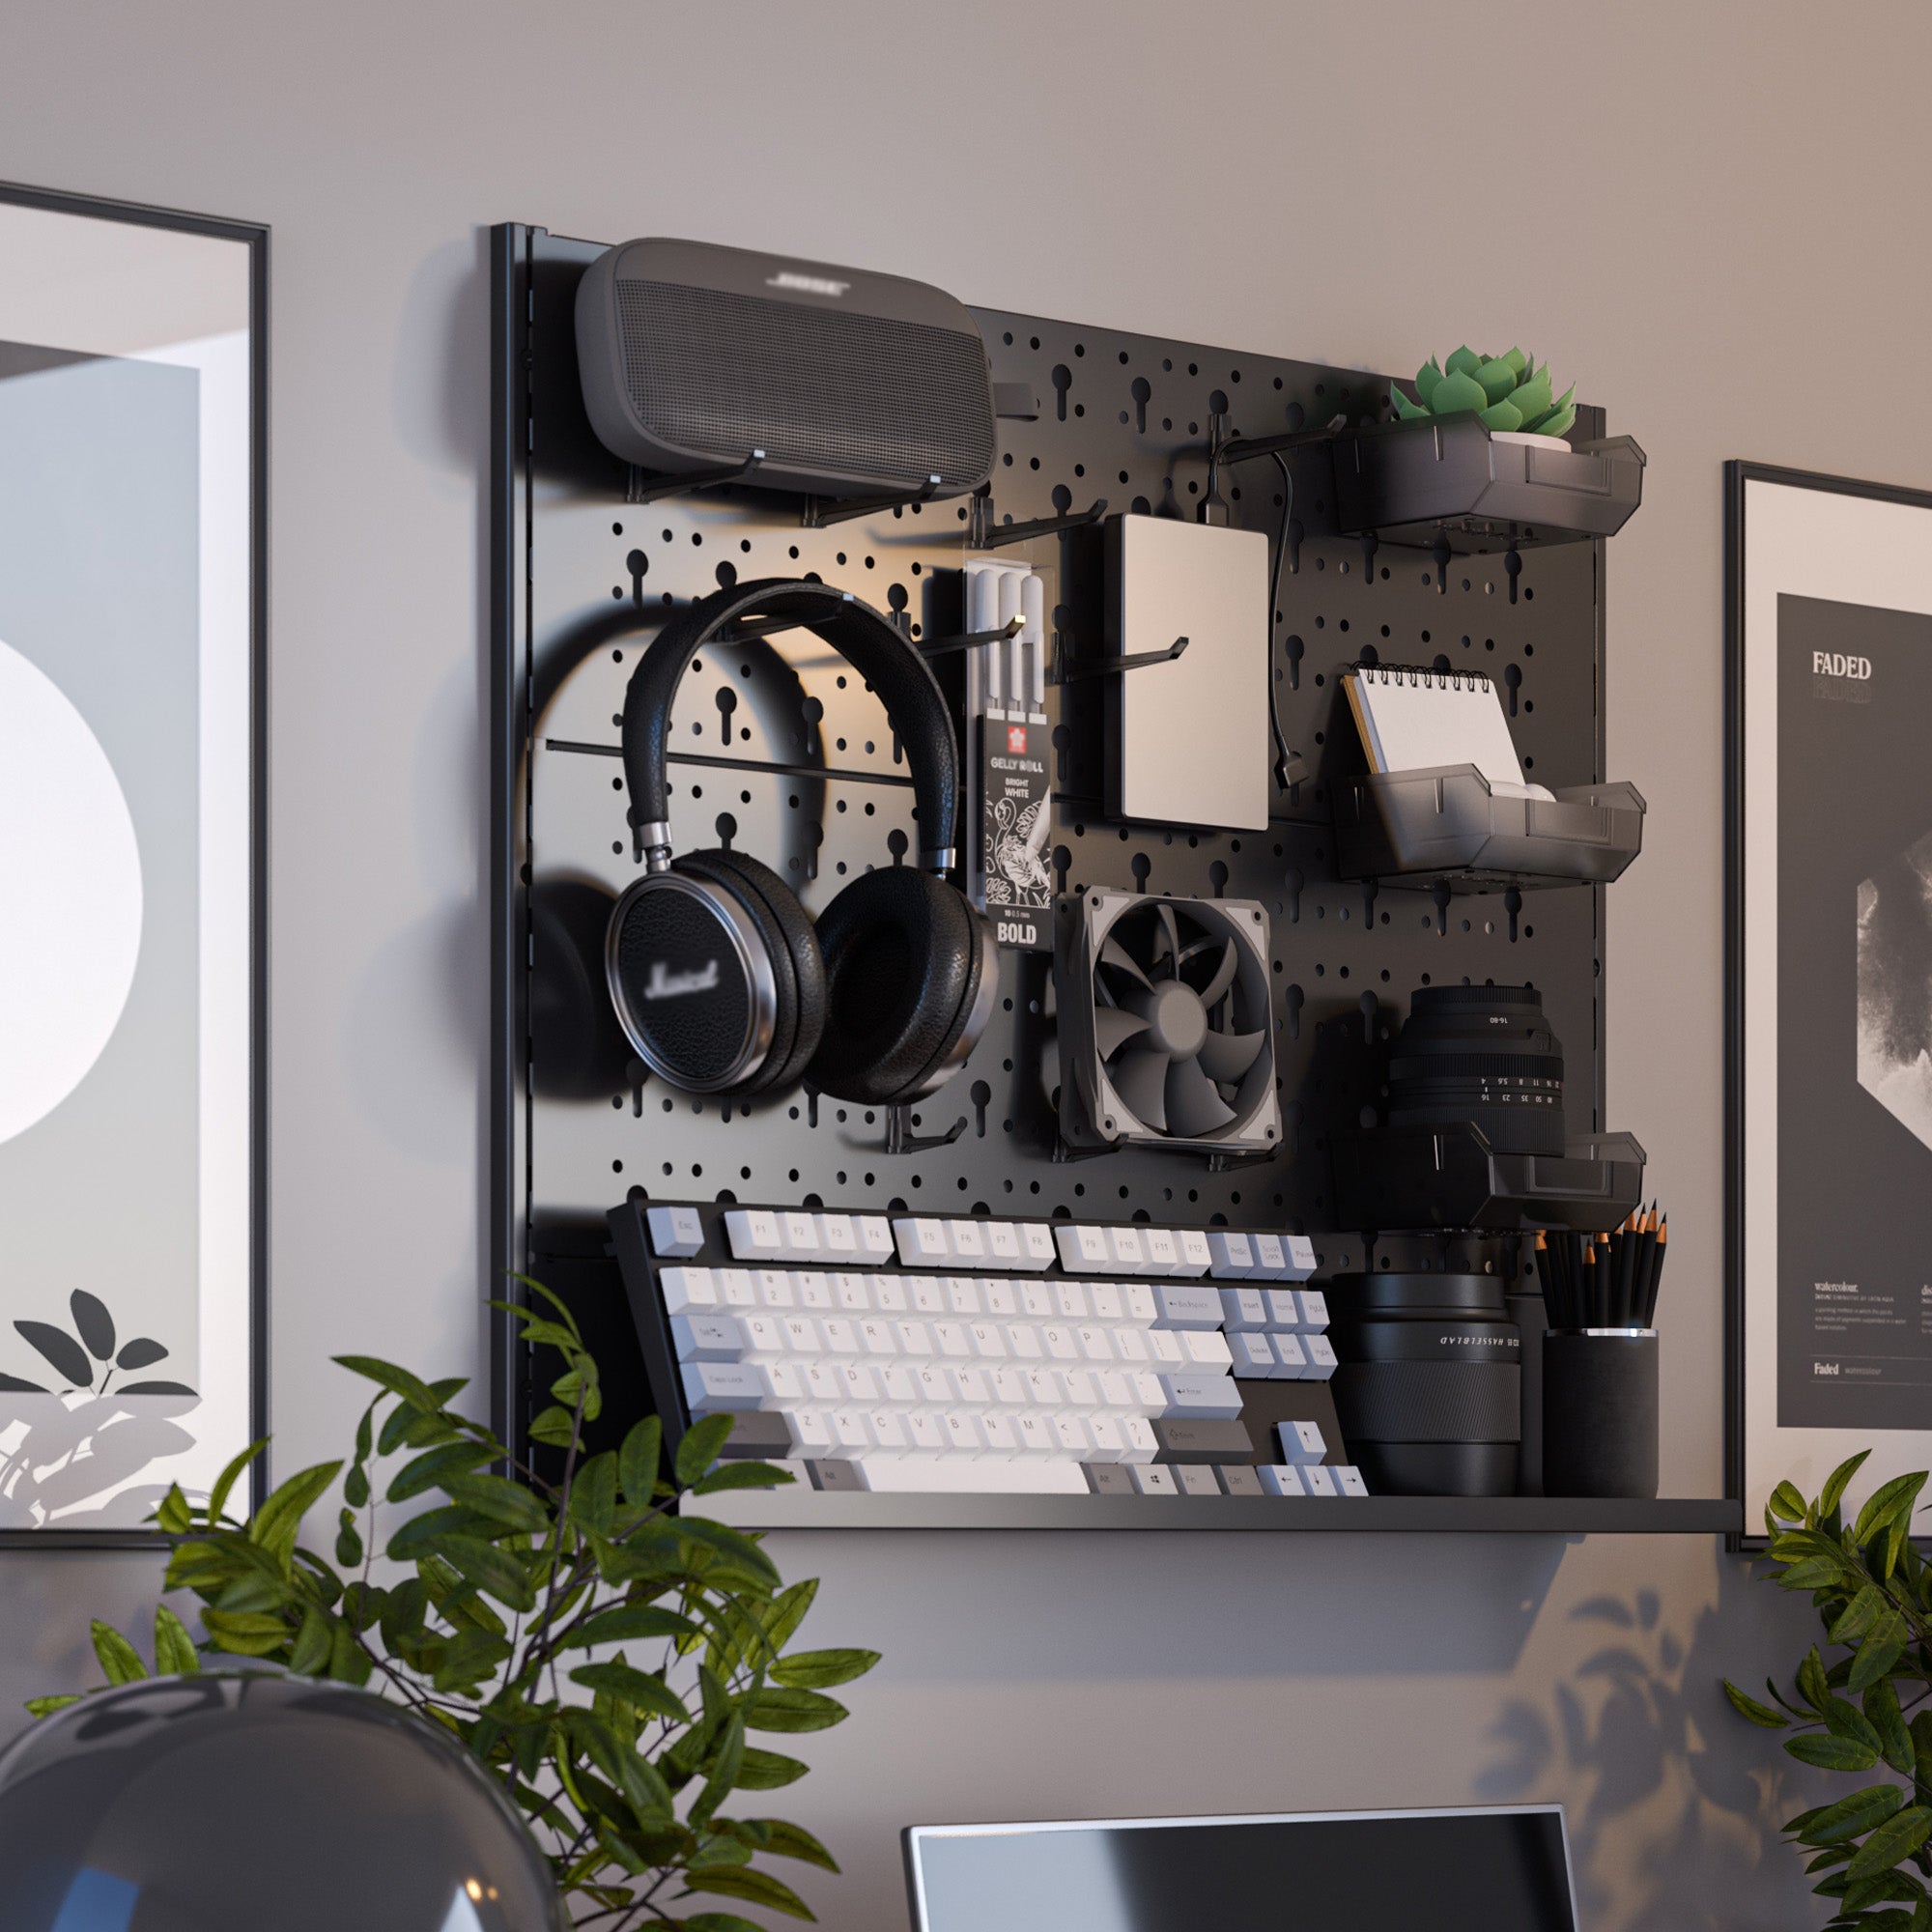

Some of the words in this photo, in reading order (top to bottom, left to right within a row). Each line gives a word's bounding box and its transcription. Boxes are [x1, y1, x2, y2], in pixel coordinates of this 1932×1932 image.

[1812, 651, 1872, 680] FADED
[990, 756, 1018, 770] GELLY
[1019, 759, 1043, 773] ROLL
[1005, 778, 1029, 787] BRIGHT
[1005, 787, 1029, 798] WHITE
[997, 922, 1037, 945] BOLD
[1502, 1094, 1510, 1102] 23
[794, 1227, 805, 1236] F2
[831, 1229, 842, 1237] F3
[869, 1229, 880, 1238] F4
[923, 1232, 935, 1241] F5
[960, 1234, 972, 1243] F6
[996, 1235, 1006, 1243] F7
[1032, 1236, 1043, 1245] F8
[1086, 1239, 1096, 1248] F9
[1120, 1240, 1134, 1250] F10
[1155, 1242, 1169, 1251] F11
[1188, 1244, 1203, 1253] F12
[753, 1322, 764, 1333] Q
[790, 1323, 803, 1334] W
[829, 1324, 838, 1335] E
[867, 1325, 877, 1336] R
[903, 1326, 911, 1337] T
[939, 1327, 947, 1337] Y
[976, 1329, 985, 1340] U
[1012, 1330, 1017, 1340] I
[1048, 1331, 1058, 1342] O
[1083, 1332, 1091, 1341] P
[1440, 1337, 1504, 1346] HASSELBLAD
[1814, 1362, 1839, 1376] Faded
[774, 1369, 782, 1378] A
[810, 1370, 819, 1379] S
[847, 1370, 857, 1380] D
[885, 1371, 891, 1381] F
[923, 1372, 932, 1382] G
[959, 1374, 969, 1383] H
[997, 1375, 1003, 1384] J
[1031, 1376, 1040, 1385] K
[1066, 1377, 1074, 1386] L
[804, 1416, 812, 1427] Z
[839, 1416, 850, 1427] X
[876, 1417, 886, 1428] C
[915, 1418, 923, 1428] V
[951, 1418, 959, 1429] B
[986, 1419, 996, 1429] N
[1023, 1420, 1034, 1430] M
